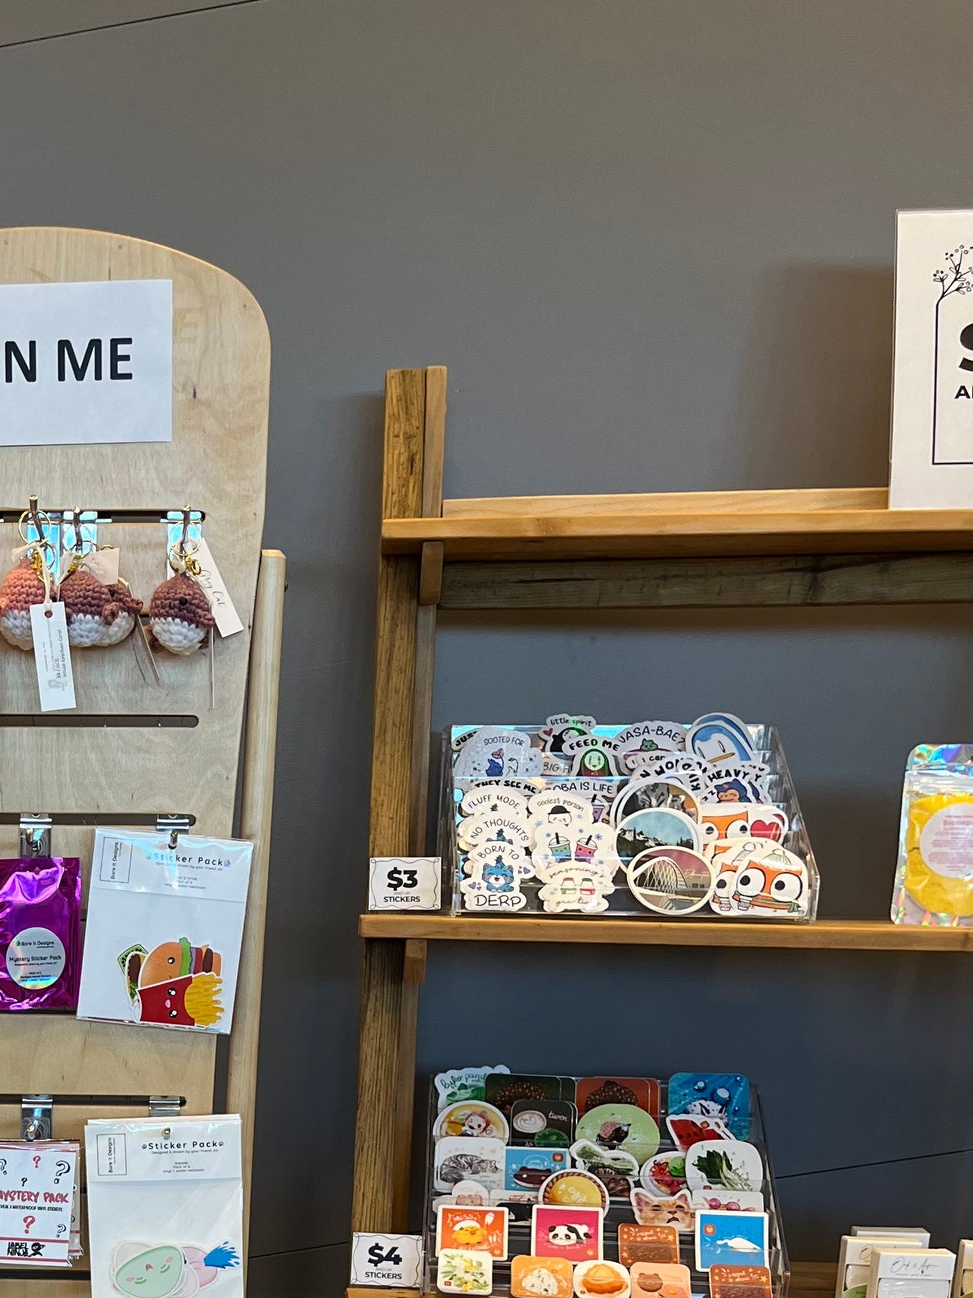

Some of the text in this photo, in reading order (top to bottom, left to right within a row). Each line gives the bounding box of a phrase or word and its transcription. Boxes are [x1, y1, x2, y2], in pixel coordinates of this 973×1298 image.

[57, 337, 133, 382] ME
[511, 736, 525, 746] FOR
[569, 739, 620, 751] FEED ME
[707, 768, 749, 783] HEAVY
[475, 778, 502, 788] THEY
[523, 784, 537, 793] ME
[579, 780, 590, 792] IS
[592, 783, 614, 795] LIFE
[468, 794, 521, 810] FLUFF MODE
[562, 799, 585, 812] person
[470, 818, 530, 843] NO THOUGHTS
[154, 853, 223, 866] Sticker Pack
[477, 845, 520, 861] BORN TO
[387, 867, 418, 891] $3
[475, 894, 522, 908] DERP
[43, 1192, 69, 1203] PACK
[368, 1243, 403, 1267] $4
[365, 1272, 402, 1280] STICKERS
